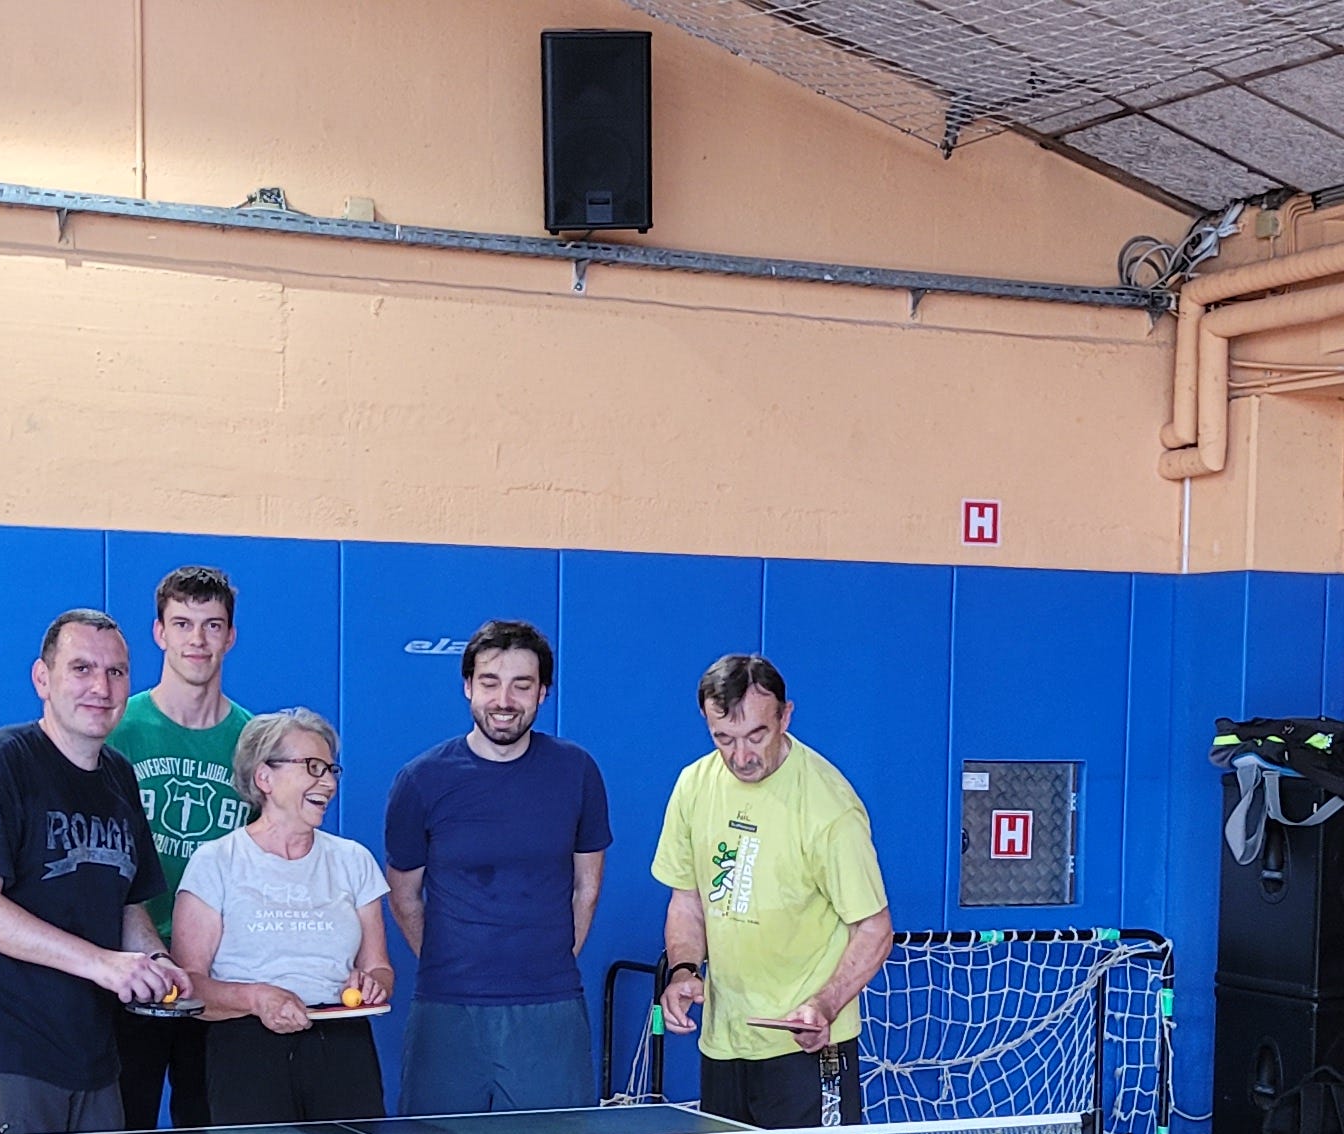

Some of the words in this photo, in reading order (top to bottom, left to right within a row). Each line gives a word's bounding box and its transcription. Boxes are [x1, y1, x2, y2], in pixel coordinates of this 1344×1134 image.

[969, 506, 994, 539] H
[404, 638, 469, 655] ela
[133, 757, 181, 782] NIVERSITY
[182, 758, 197, 778] OF
[139, 789, 156, 821] 9
[999, 817, 1025, 853] H
